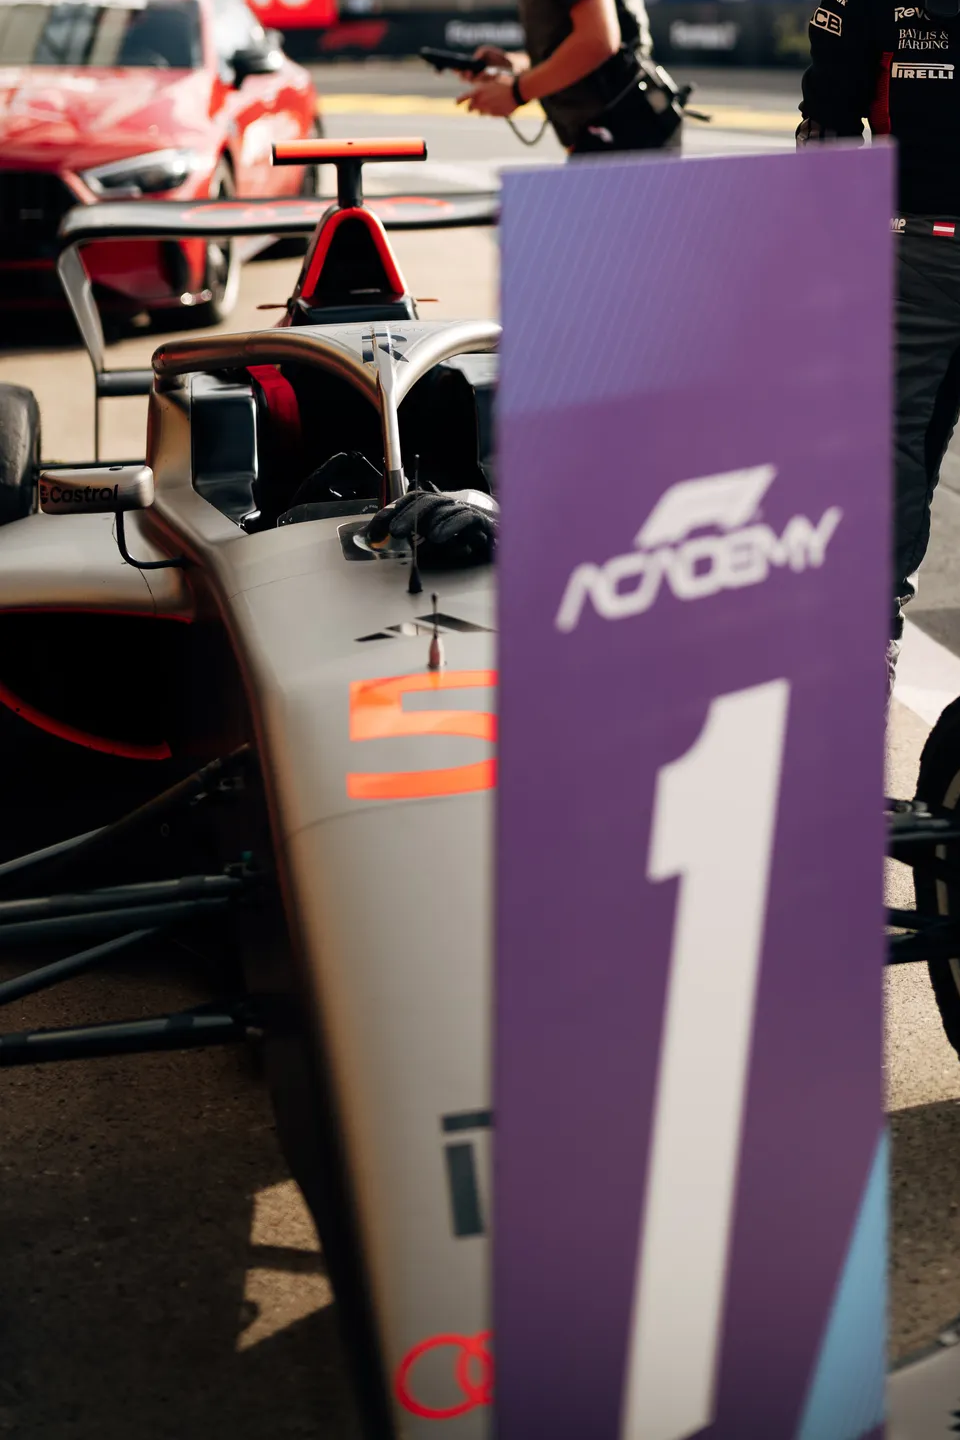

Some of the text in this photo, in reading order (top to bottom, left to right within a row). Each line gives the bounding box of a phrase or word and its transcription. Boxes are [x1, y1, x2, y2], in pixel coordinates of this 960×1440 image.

[899, 29, 948, 40] BAYLIS &
[898, 40, 949, 50] HARDING
[891, 62, 955, 79] PIRELLI
[890, 218, 907, 231] MP
[50, 484, 118, 503] Castrol
[619, 677, 791, 1440] 1
